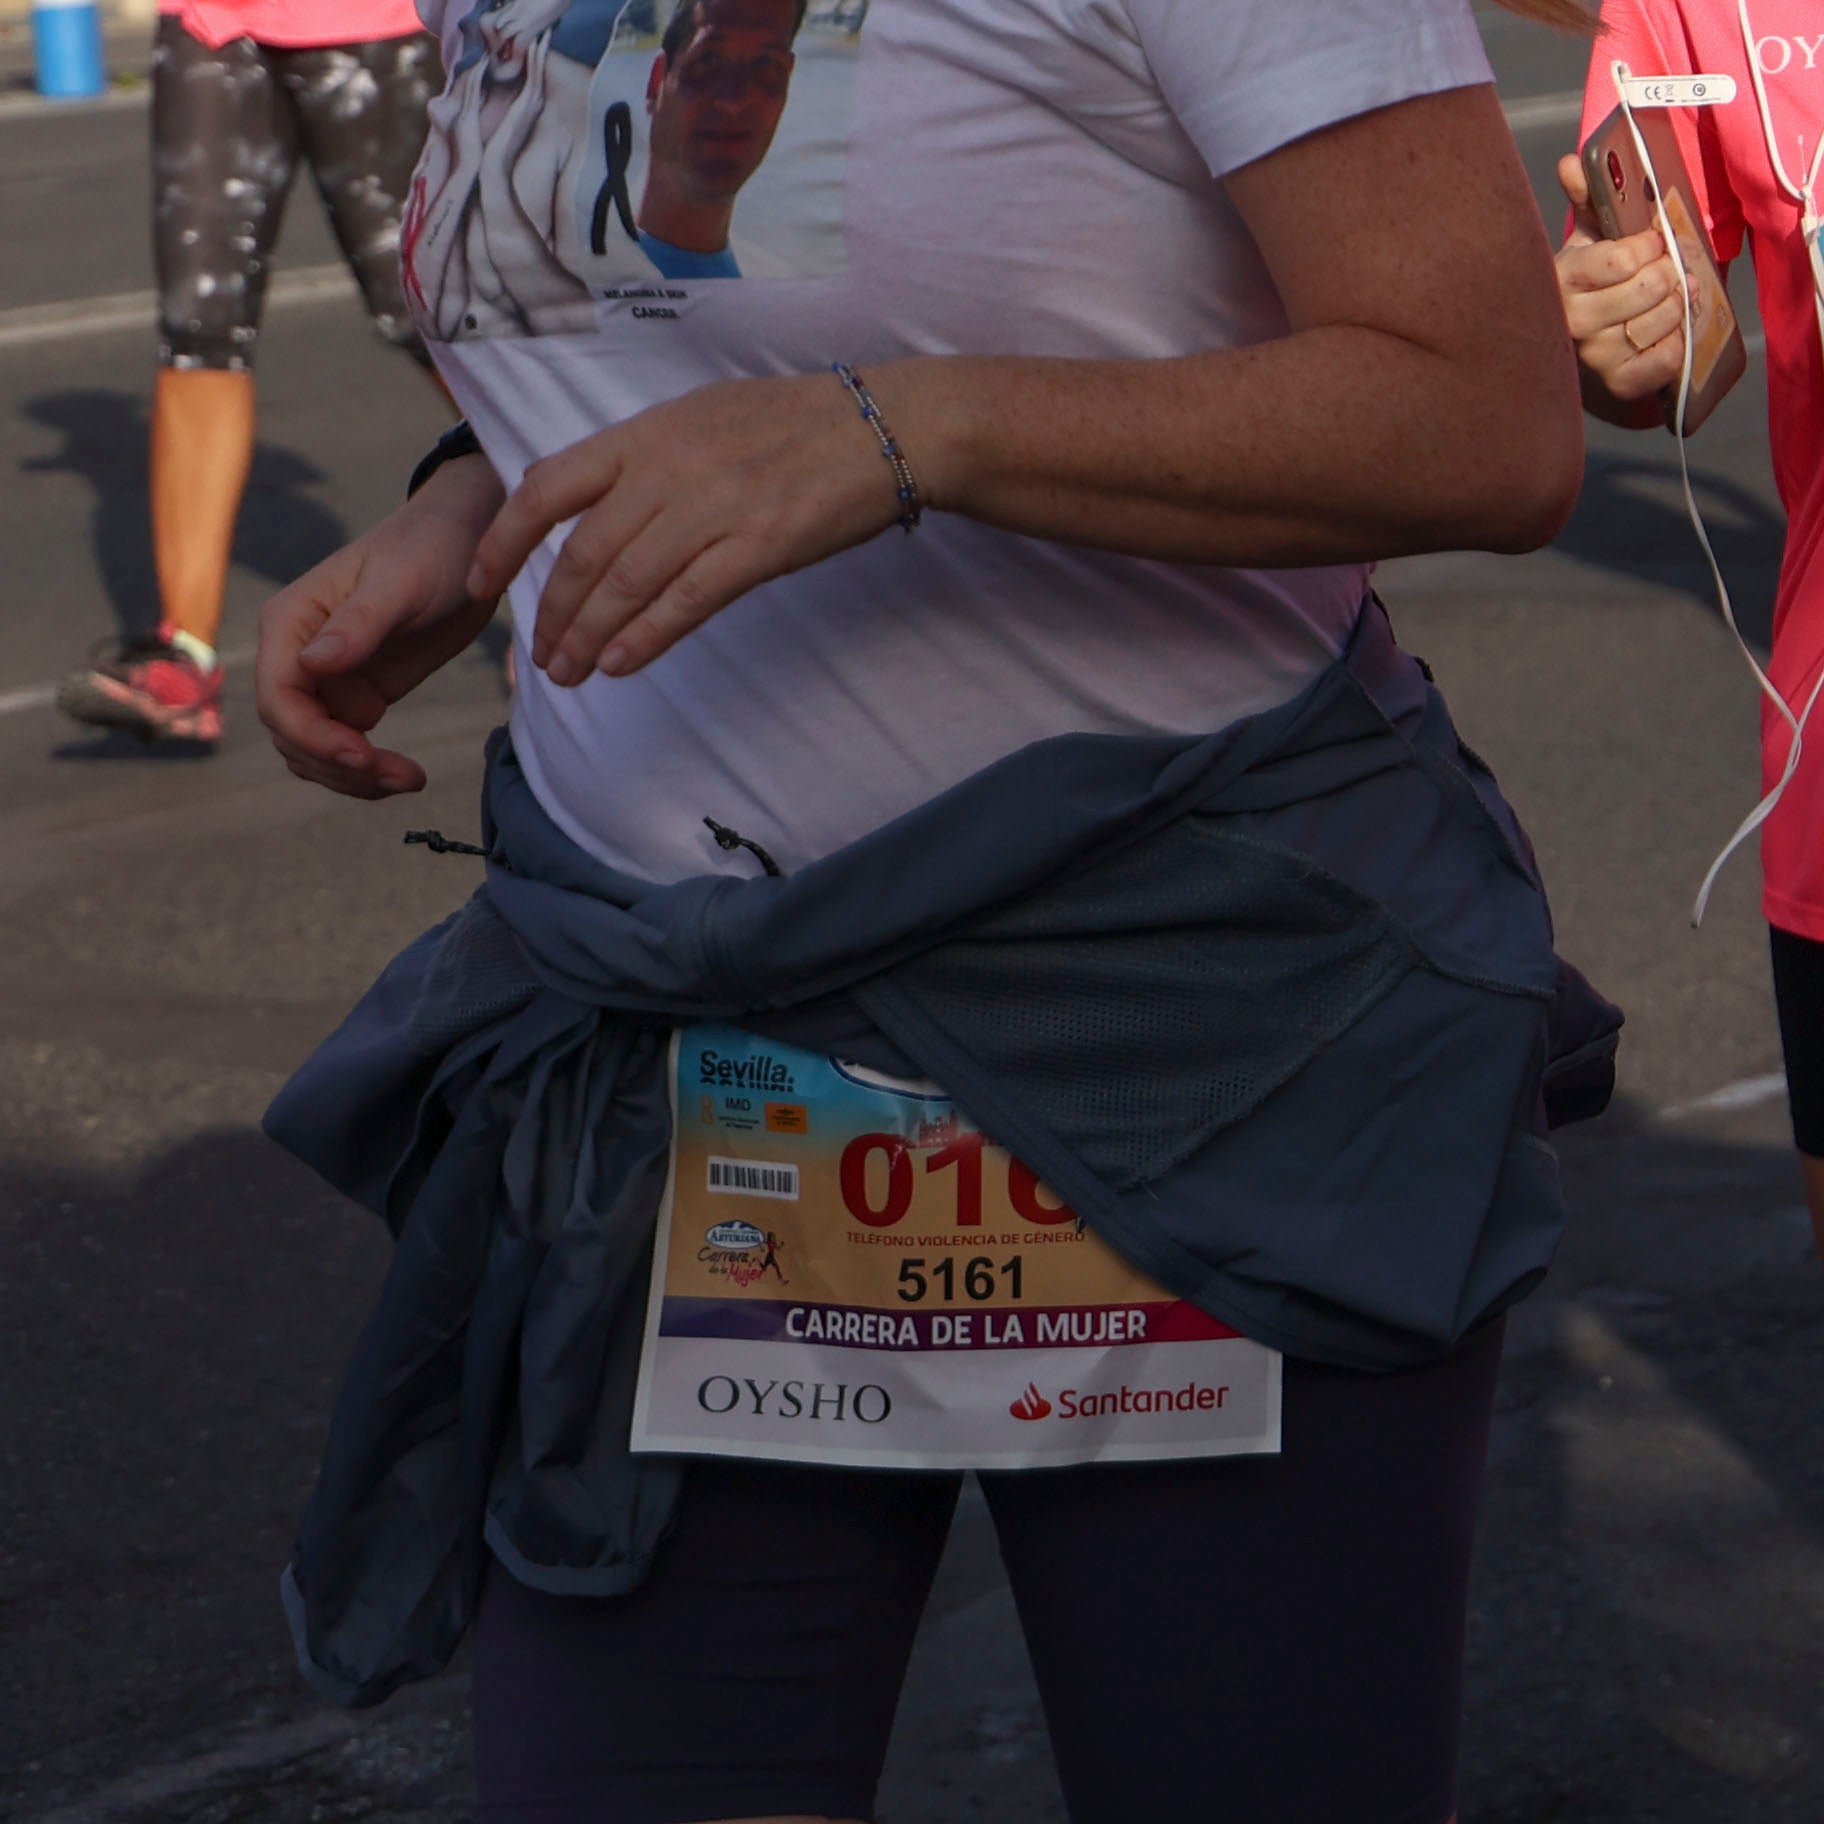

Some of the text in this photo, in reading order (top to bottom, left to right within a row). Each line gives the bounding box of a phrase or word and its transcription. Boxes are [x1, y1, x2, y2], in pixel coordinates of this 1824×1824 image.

[726, 1097, 752, 1112] IMD
[917, 1232, 997, 1247] VIOLENCIA
[1001, 1232, 1020, 1245] DE
[897, 1255, 1022, 1302] 5161
[786, 1307, 1147, 1346] CARRERA DE LA MUJER
[697, 1375, 893, 1424] OYSHO
[1057, 1382, 1230, 1420] Santander
